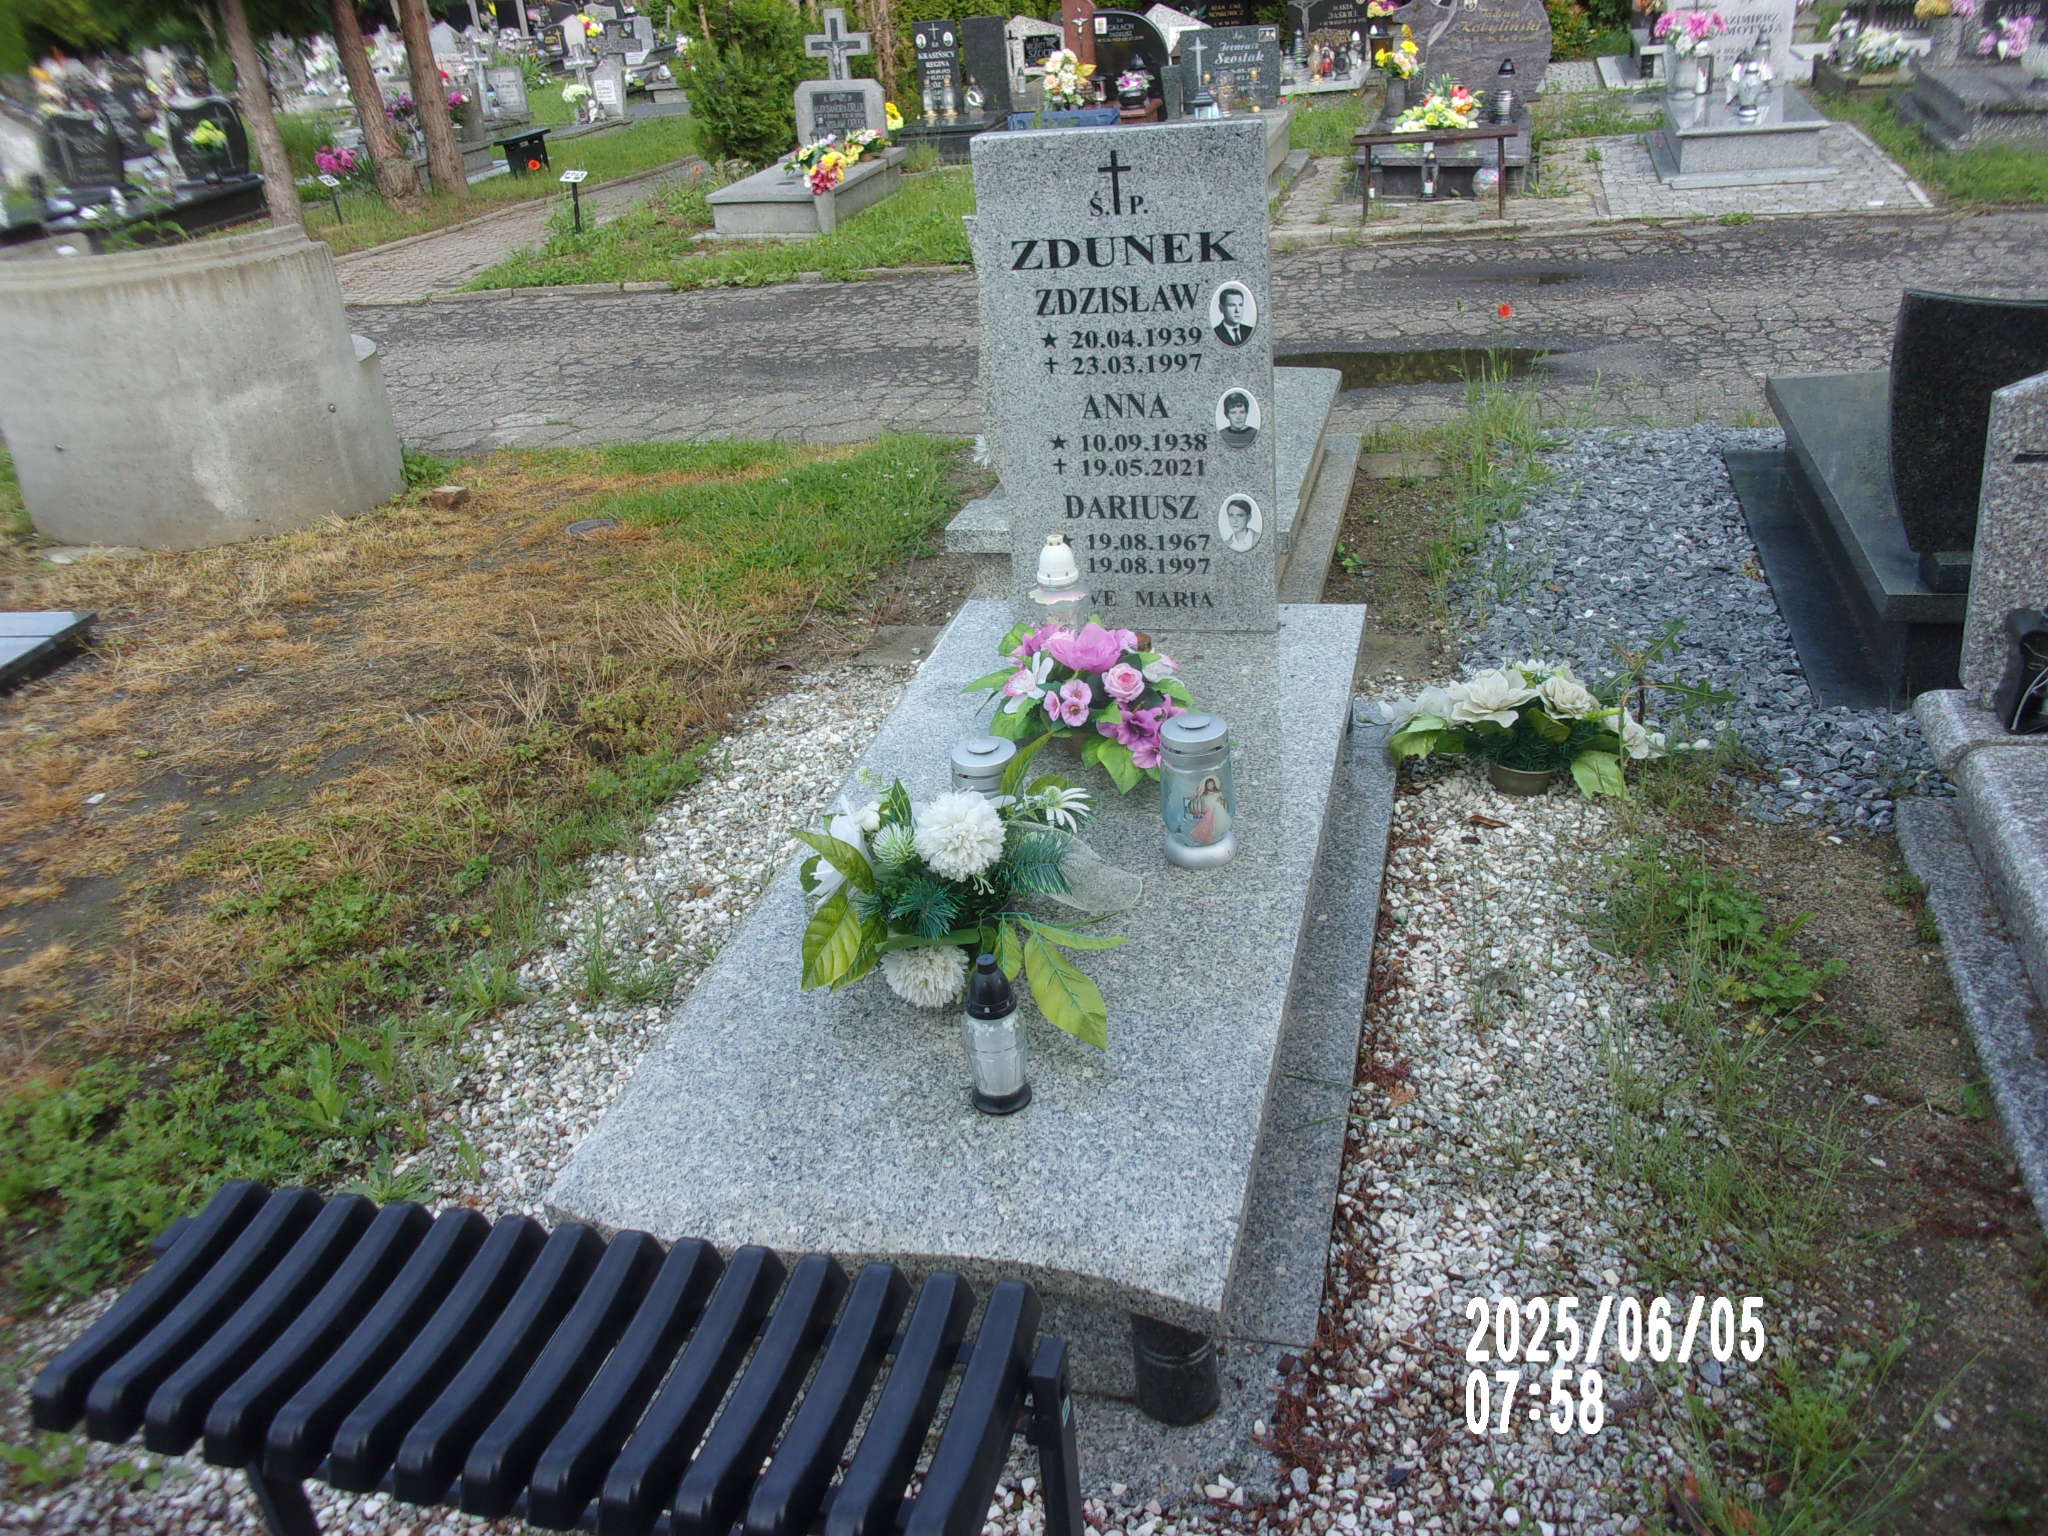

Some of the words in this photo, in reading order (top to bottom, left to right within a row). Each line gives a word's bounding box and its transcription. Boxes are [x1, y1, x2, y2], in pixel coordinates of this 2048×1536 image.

[1129, 195, 1149, 215] P.
[1011, 230, 1238, 271] ZDUNEK
[1035, 283, 1200, 316] ZDZISŁAW
[1070, 326, 1203, 350] 20.04.1939
[1071, 353, 1203, 375] 23.03.1997
[1082, 392, 1170, 419] ANNA
[1081, 433, 1208, 452] 10.09.1938
[1082, 458, 1206, 477] 19.05.2021
[1063, 494, 1200, 520] DARIUSZ
[1087, 533, 1211, 551] 19.08.1967
[1088, 557, 1211, 575] 19.08.1997
[1090, 590, 1117, 607] VE
[1135, 590, 1215, 608] MARIA
